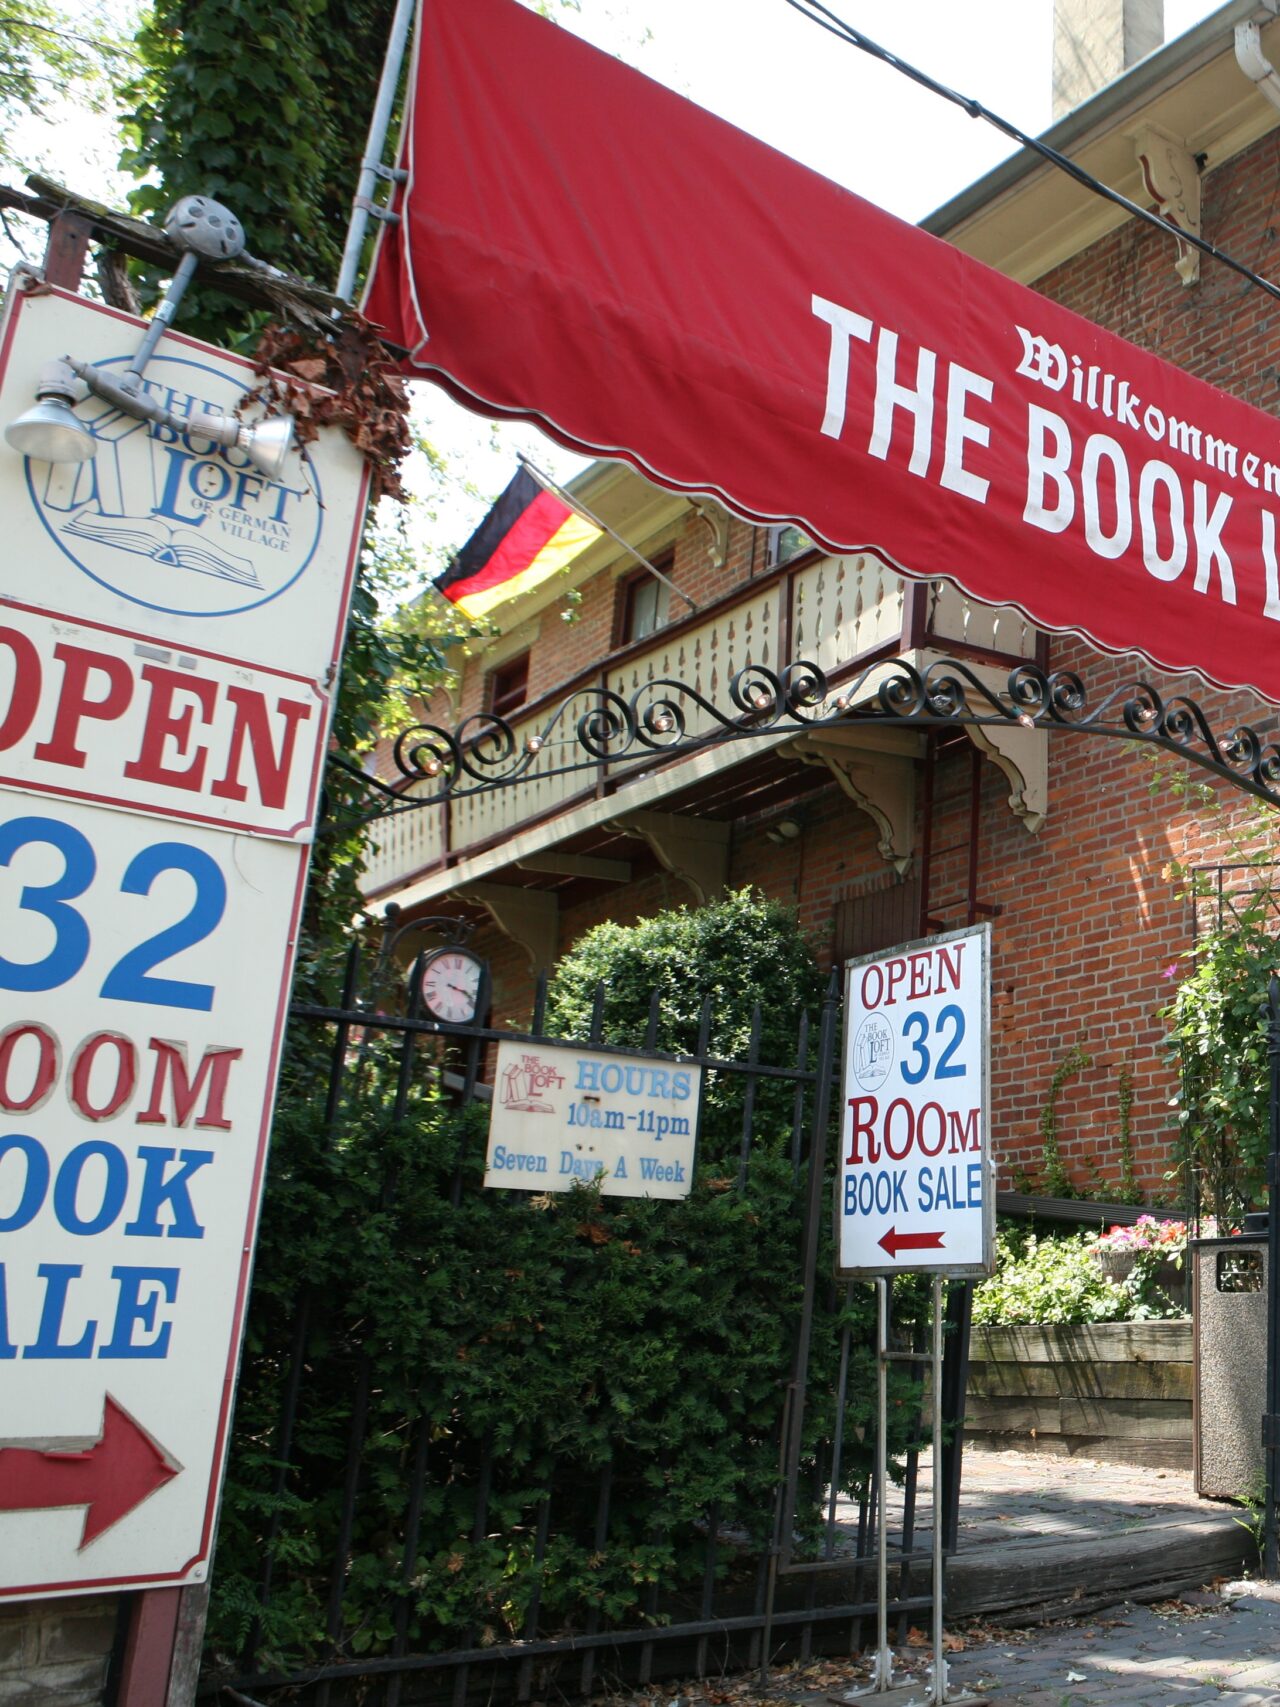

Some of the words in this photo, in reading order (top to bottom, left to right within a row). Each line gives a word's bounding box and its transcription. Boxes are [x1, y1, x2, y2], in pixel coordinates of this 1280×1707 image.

[812, 295, 993, 504] THE
[1022, 403, 1237, 605] BOOK
[151, 446, 303, 527] LOFT
[219, 507, 291, 537] GERMAN
[221, 520, 290, 552] VILLAGE
[0, 816, 227, 1012] 32
[861, 943, 967, 1010] OPEN
[521, 1055, 540, 1065] THE
[869, 1038, 891, 1064] LOFT
[900, 1004, 967, 1085] 32
[0, 1020, 244, 1132] OOM
[524, 1064, 557, 1076] BOOK
[527, 1073, 566, 1097] LOFT
[575, 1060, 691, 1101] HOURS
[567, 1103, 690, 1141] 10am-11pm
[846, 1095, 981, 1165] ROOM
[0, 1134, 214, 1239] OOK
[493, 1145, 548, 1173] Seven
[559, 1151, 604, 1181] Days
[614, 1156, 628, 1178] A
[640, 1157, 686, 1183] Week
[844, 1170, 909, 1216] BOOK
[917, 1163, 982, 1213] SALE
